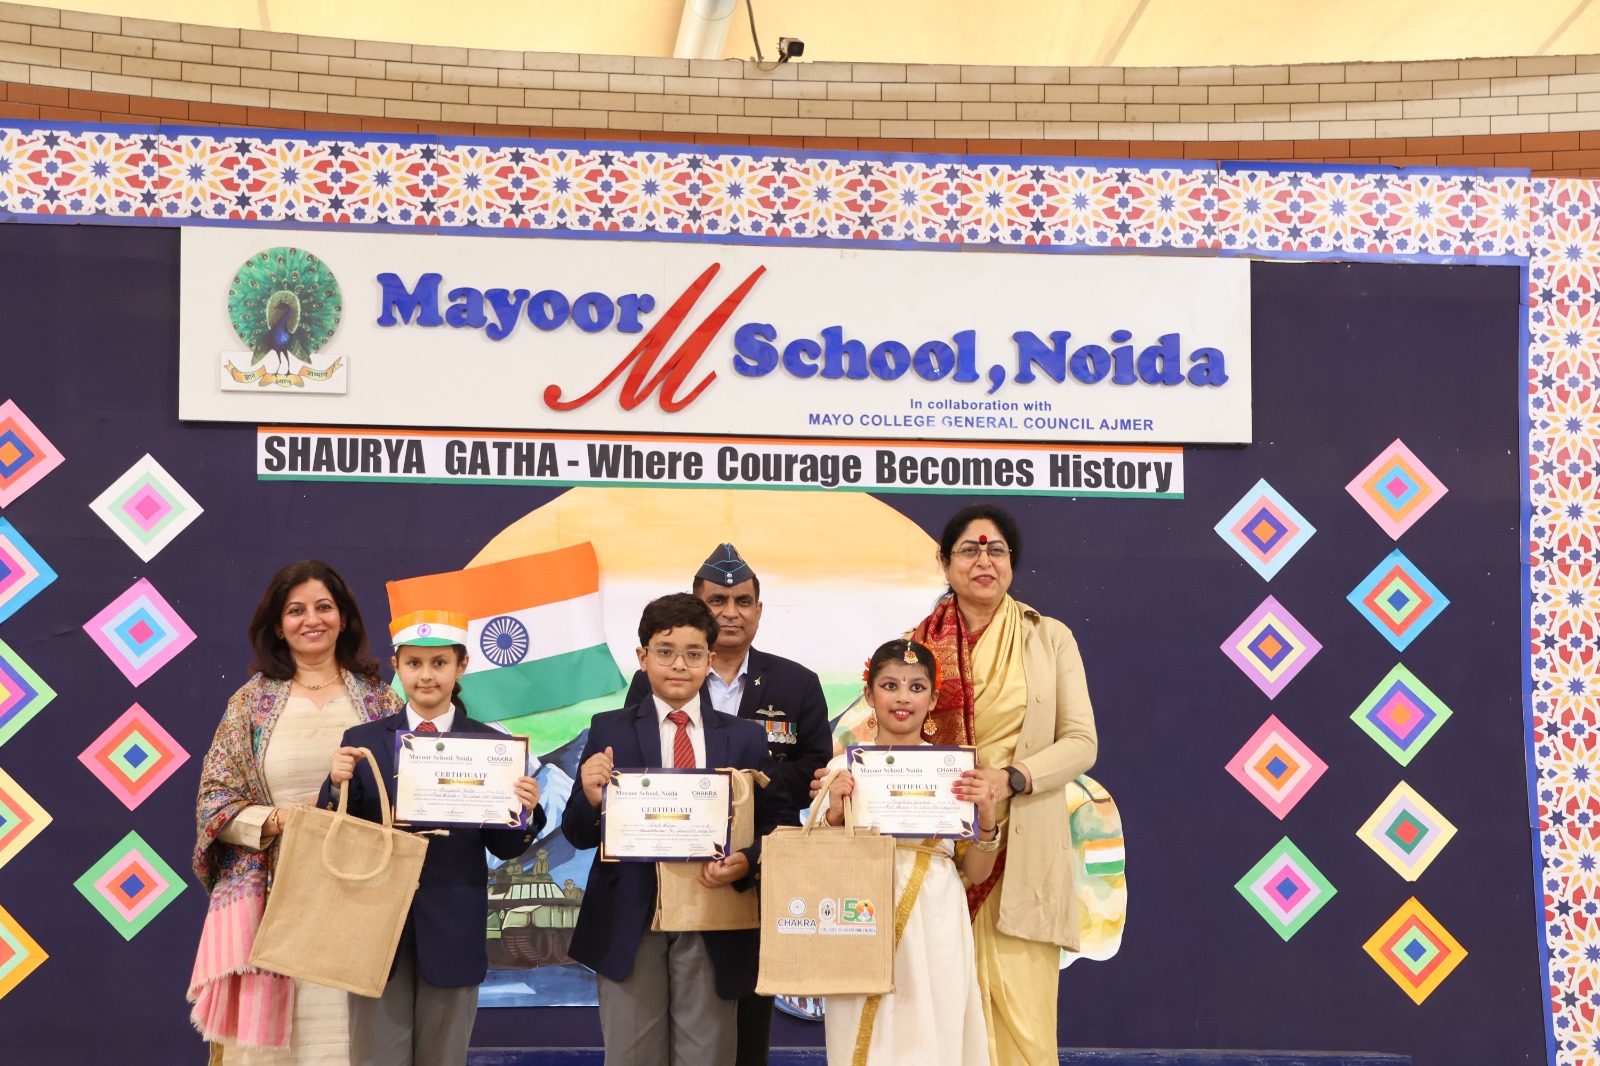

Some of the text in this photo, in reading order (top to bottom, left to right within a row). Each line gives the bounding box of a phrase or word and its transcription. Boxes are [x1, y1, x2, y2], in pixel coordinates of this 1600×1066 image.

[377, 272, 655, 340] Mayoor
[733, 322, 1229, 394] School, Noida
[910, 399, 1052, 411] In collaboration with
[808, 412, 1154, 431] MAYO COLLEGE GENERAL COUNCIL AJMER
[264, 435, 426, 474] SHAURYA
[445, 439, 559, 477] GATHA
[587, 443, 703, 480] Where
[716, 446, 862, 487] Courage
[875, 450, 1034, 487] Becomes
[1049, 453, 1173, 493] History
[409, 753, 431, 761] Mayoor
[435, 771, 489, 779] CERTIFICATE
[615, 790, 637, 798] Mayoor
[777, 918, 817, 927] CHAKRA
